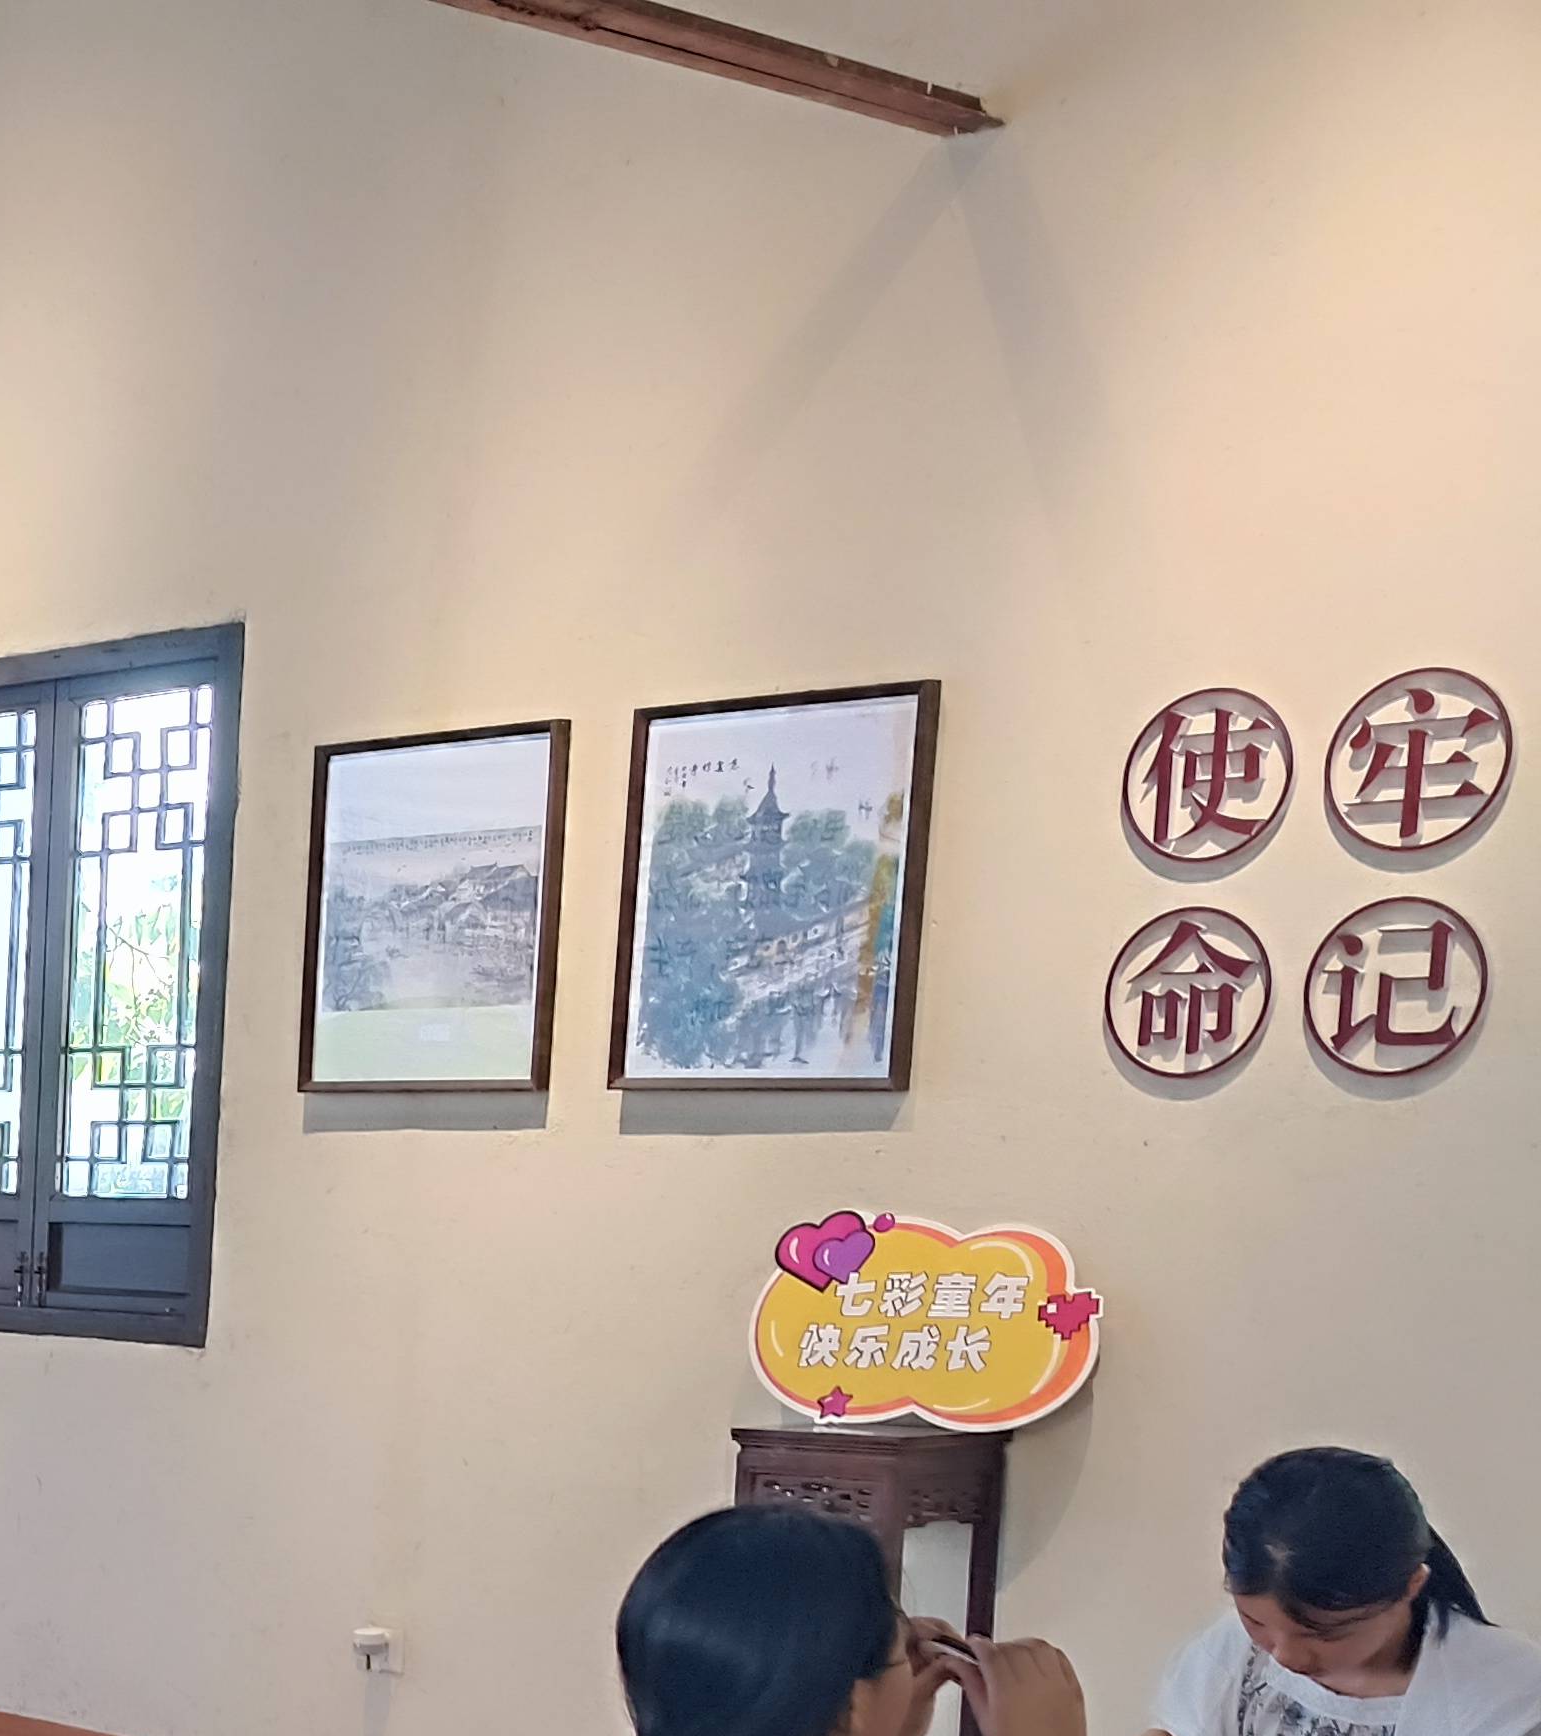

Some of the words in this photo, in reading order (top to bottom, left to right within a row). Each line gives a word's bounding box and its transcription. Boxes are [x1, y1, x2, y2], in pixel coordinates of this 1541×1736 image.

[835, 1271, 1030, 1319] 七彩童年
[797, 1323, 992, 1372] 快乐成长
